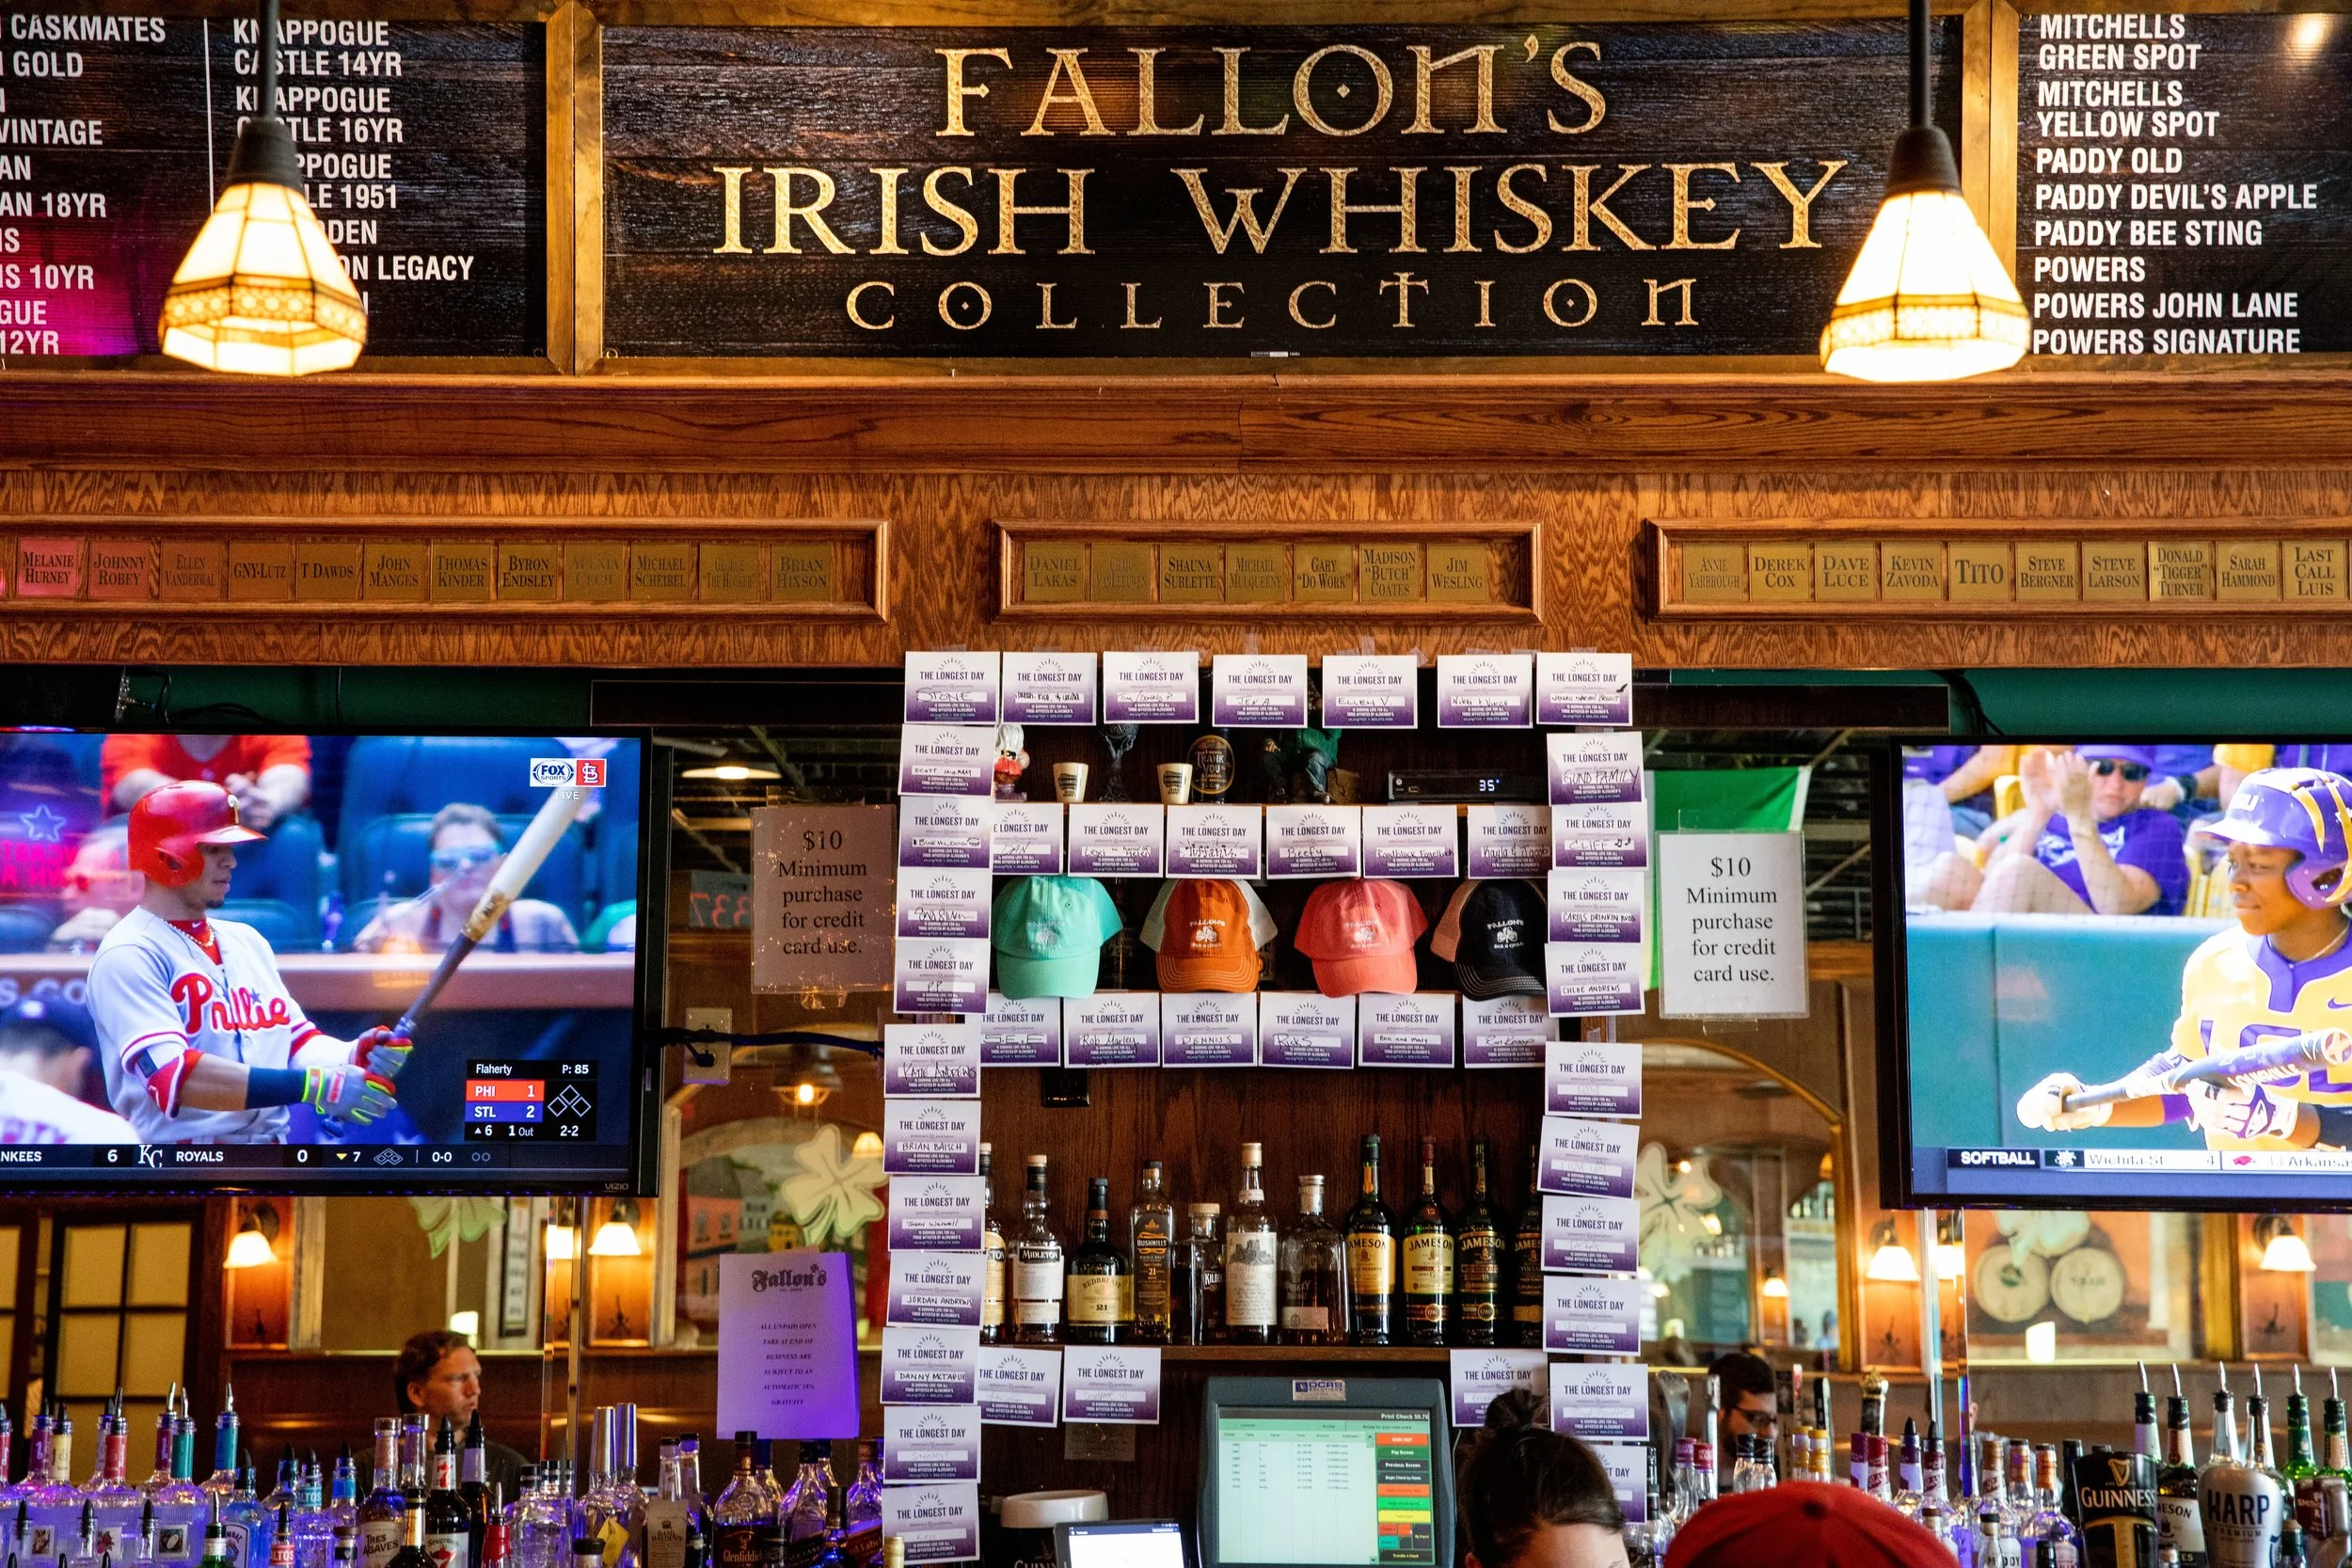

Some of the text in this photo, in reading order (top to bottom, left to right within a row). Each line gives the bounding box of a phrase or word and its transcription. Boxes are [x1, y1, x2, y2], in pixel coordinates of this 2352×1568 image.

[11, 14, 166, 42] CASKMATES
[2040, 13, 2185, 40] MITCHELLS
[13, 51, 84, 77] GOLD
[235, 49, 402, 76] CSTLE 14YR
[2039, 43, 2201, 71] GREEN SPOT
[934, 34, 1608, 137] FALLON'S
[2038, 81, 2183, 107] MITCHELLS
[339, 118, 404, 143] 16YR
[2037, 111, 2220, 137] YELLOW SPOT
[2036, 148, 2183, 174] PADDY OLD
[41, 193, 106, 217] 18YR
[341, 184, 396, 209] 1951
[2036, 183, 2317, 210] PADDY DEVIL'S APPLE
[712, 160, 1849, 256] IRISH WHISKEY
[2035, 220, 2263, 246] PADDY BEE STING
[378, 256, 474, 280] LEGACY
[2034, 256, 2146, 283] POWERS
[30, 264, 94, 290] 10YR
[846, 272, 1698, 330] COLLECTION
[2033, 292, 2297, 319] POWERS JOHN LANE
[2032, 328, 2300, 355] POWERS SIGNATURE
[23, 551, 74, 569] MELANIE
[94, 553, 146, 570] JOHNNY
[1363, 549, 1416, 566] MADISON
[2157, 547, 2203, 563] DONALD
[2295, 546, 2334, 562] LAST
[301, 564, 310, 579] T
[376, 555, 411, 572] JOHN
[436, 555, 488, 572] THOMAS
[508, 555, 549, 572] BYRON
[637, 555, 686, 572] MICHAEL
[780, 556, 824, 573] BRIAN
[1029, 555, 1082, 573] DANIEL
[1168, 556, 1212, 573] SHAUNA
[1311, 556, 1337, 574] GARY
[1446, 556, 1468, 573] JIM
[1754, 557, 1806, 572] DEREK
[1822, 556, 1869, 571] DAVE
[1891, 556, 1934, 571] KEVIN
[2028, 556, 2065, 572] STEVE
[2092, 556, 2136, 572] STEVE
[2230, 555, 2265, 571] SARAH
[2295, 563, 2336, 579] CALL
[24, 568, 71, 584] HURNEY
[98, 570, 140, 587] ROBEY
[368, 572, 419, 588] MANGES
[437, 572, 485, 588] KINDER
[502, 572, 555, 589] ENDSLEY
[635, 572, 686, 589] SCHEIBEL
[1765, 572, 1795, 588] COX
[1823, 572, 1869, 588] LUCE
[1886, 572, 1939, 588] ZAVODA
[1955, 560, 2004, 585] TITO
[2020, 573, 2074, 588] BERGNER
[2088, 572, 2140, 588] LARSON
[2221, 572, 2275, 588] HAMMOND
[1164, 573, 1216, 590] SUBLETTE
[1370, 581, 1410, 597] COATES
[1432, 573, 1484, 590] WESLING
[2158, 581, 2203, 596] TURNER
[2297, 579, 2334, 596] LUIS
[1338, 676, 1403, 685] THE LONGEST DAY
[541, 765, 565, 776] FOX
[556, 791, 580, 800] LIVE
[803, 830, 843, 851] $10
[779, 861, 867, 878] Minimum
[1710, 856, 1752, 879] $10
[783, 886, 863, 908] purchase
[1687, 887, 1778, 904] Minimum
[783, 911, 865, 928] for credit
[1692, 912, 1773, 934] purchase
[783, 937, 862, 954] card use.
[1692, 938, 1776, 956] for credit
[1561, 962, 1627, 974] THE LONGEST DAY
[1693, 965, 1774, 982] card use.
[475, 1063, 513, 1076] Flaherty
[562, 1064, 589, 1074] P: 85
[475, 1085, 535, 1098] PHI 1
[474, 1105, 535, 1118] STL 2
[485, 1125, 493, 1136] 6
[508, 1125, 533, 1137] 1 Out
[560, 1125, 579, 1137] 2-2
[899, 1120, 965, 1131] THE LONGEST DAY
[902, 1142, 930, 1150] BRIAN
[106, 1149, 119, 1164] 6
[176, 1150, 224, 1163] ROYALS
[296, 1149, 309, 1164] 0
[353, 1150, 361, 1163] 7
[432, 1149, 453, 1163] 0-0
[1961, 1151, 2035, 1165] SOFTBALL
[2089, 1154, 2164, 1167] Wichita St
[605, 1182, 629, 1191] VIZIO
[1136, 1239, 1168, 1247] BUSHMILLS
[1409, 1238, 1454, 1252] JAMESON
[1461, 1237, 1506, 1251] JAMESON
[1022, 1249, 1058, 1259] MIDLETON
[752, 1268, 827, 1292] Fallon's
[898, 1349, 963, 1359] THE LONGEST DAY
[2081, 1486, 2156, 1508] GUINNESS
[2207, 1490, 2269, 1525] HARP
[363, 1540, 399, 1557] AGAVES
[366, 1534, 386, 1546] TRES
